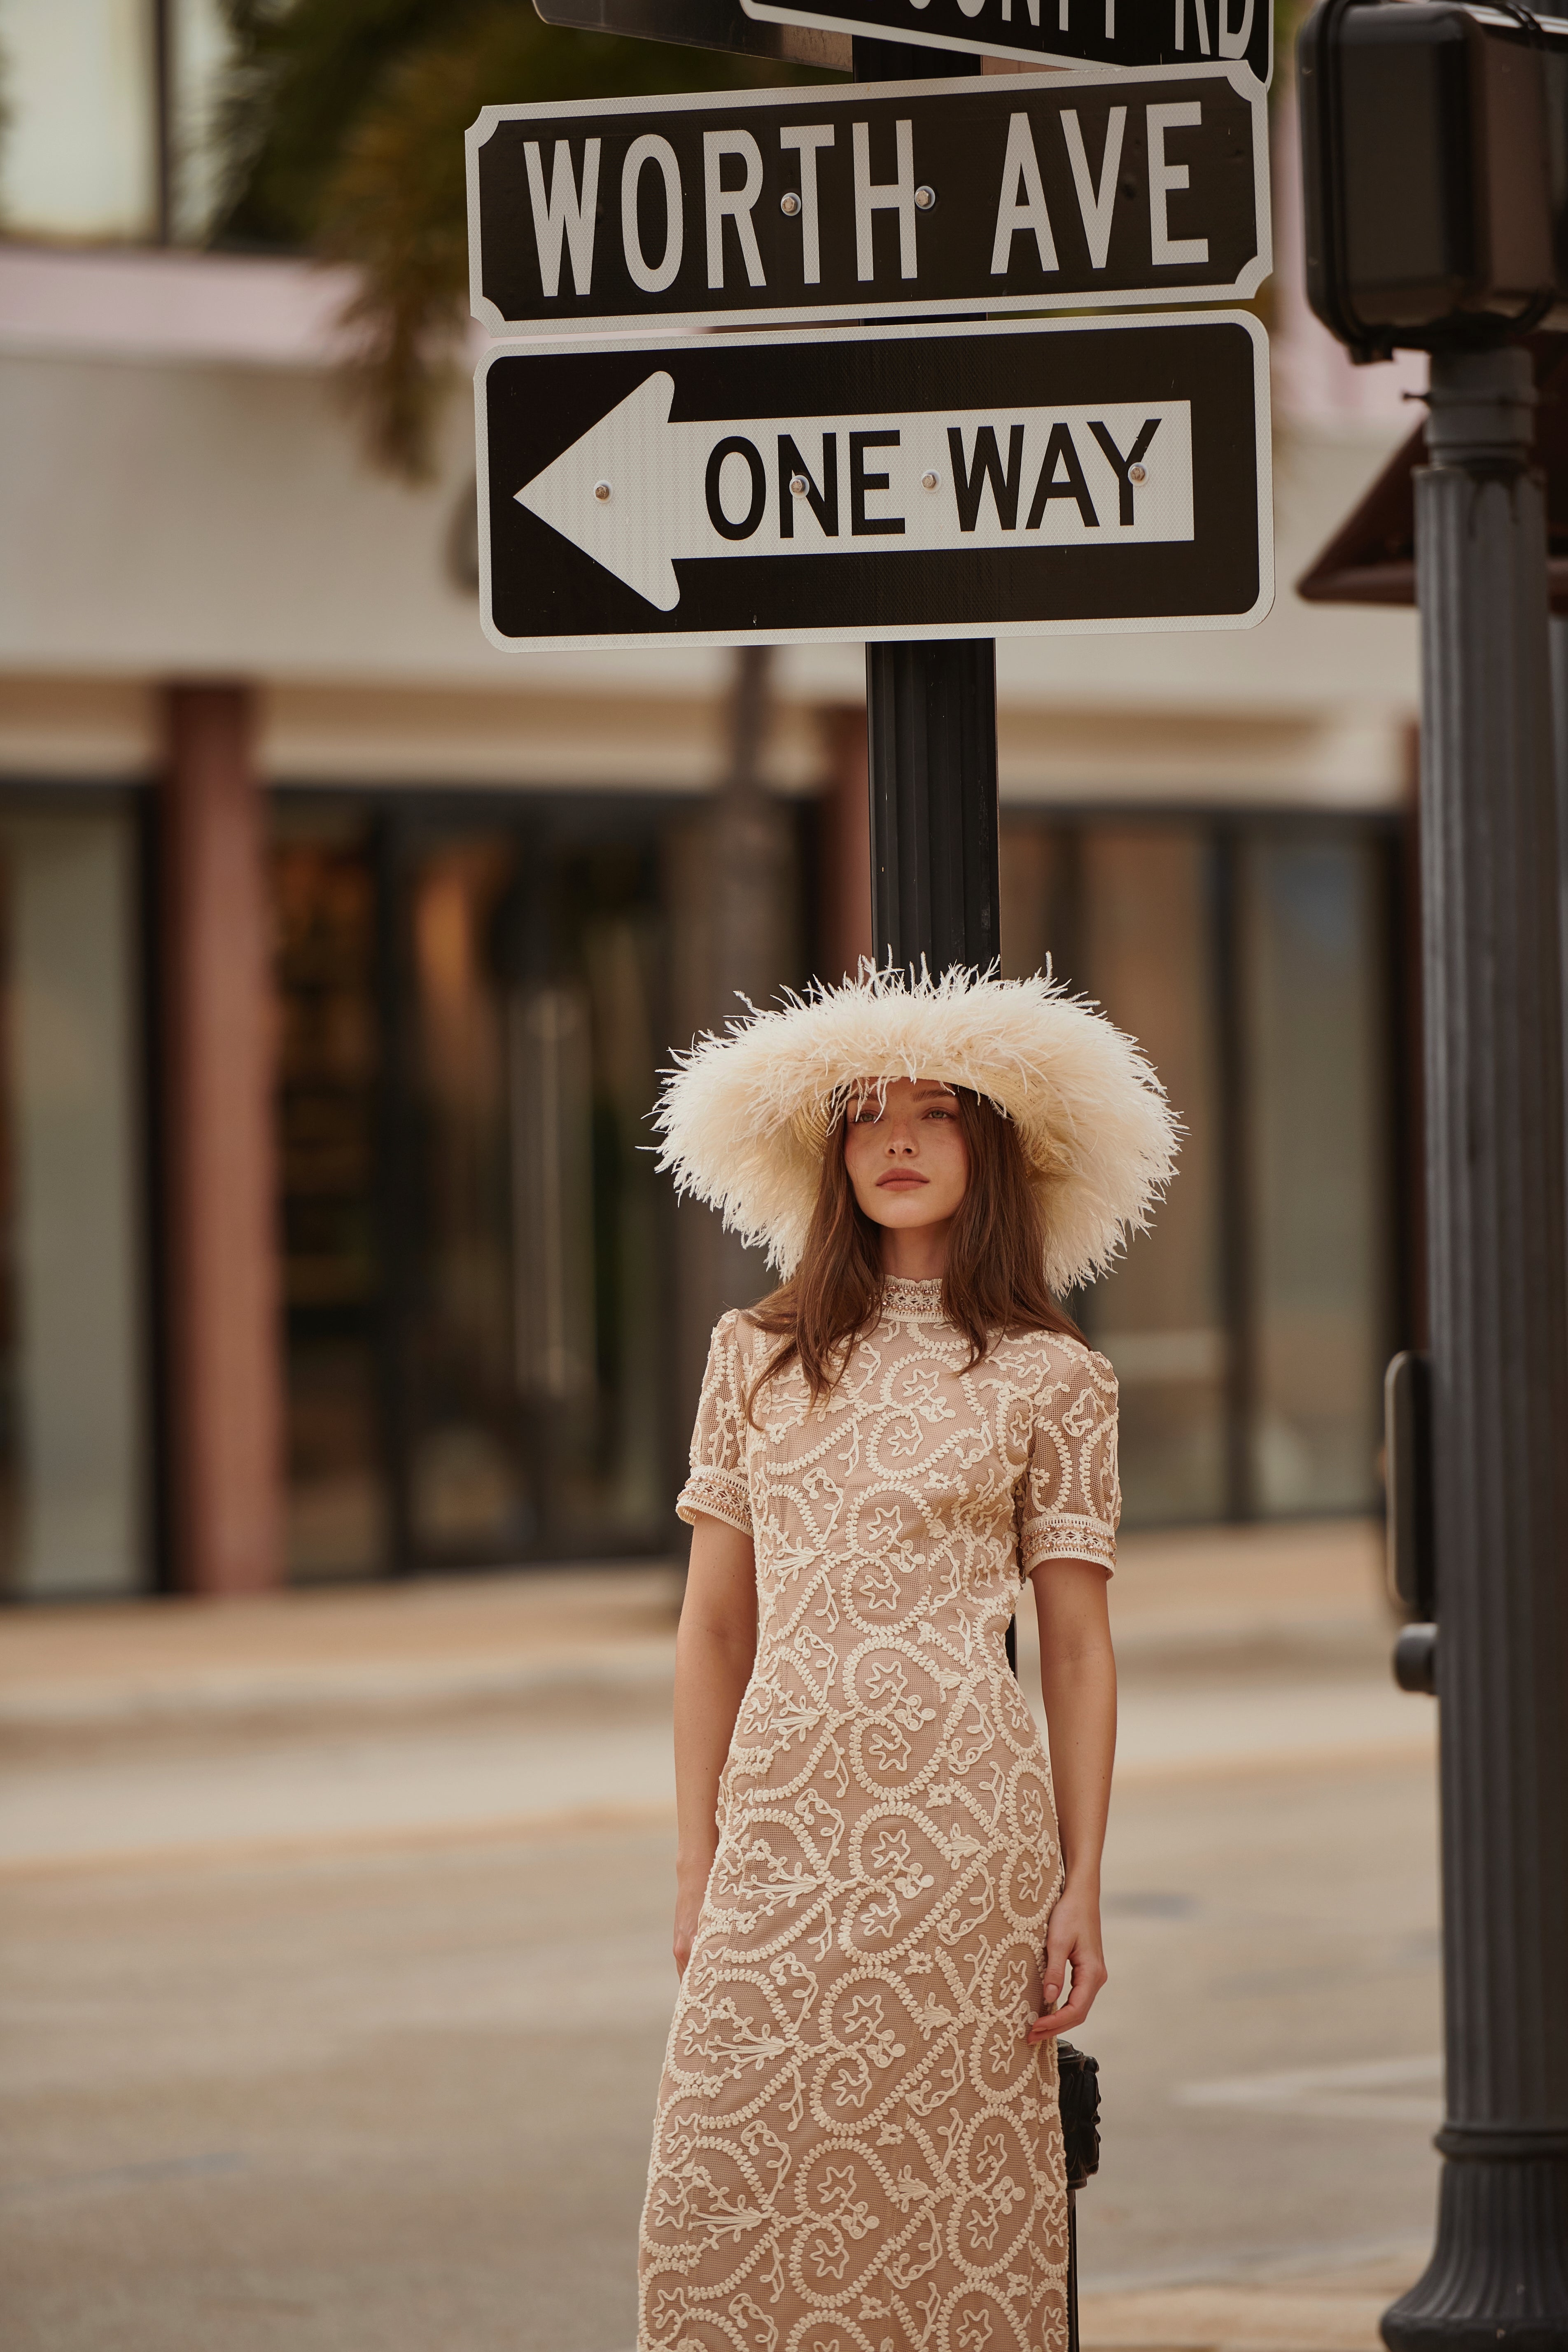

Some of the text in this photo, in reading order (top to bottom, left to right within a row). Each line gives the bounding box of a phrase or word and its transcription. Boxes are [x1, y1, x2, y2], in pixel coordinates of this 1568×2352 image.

[523, 101, 1209, 297] WORTH AVE
[705, 418, 1163, 541] ONE WAY
